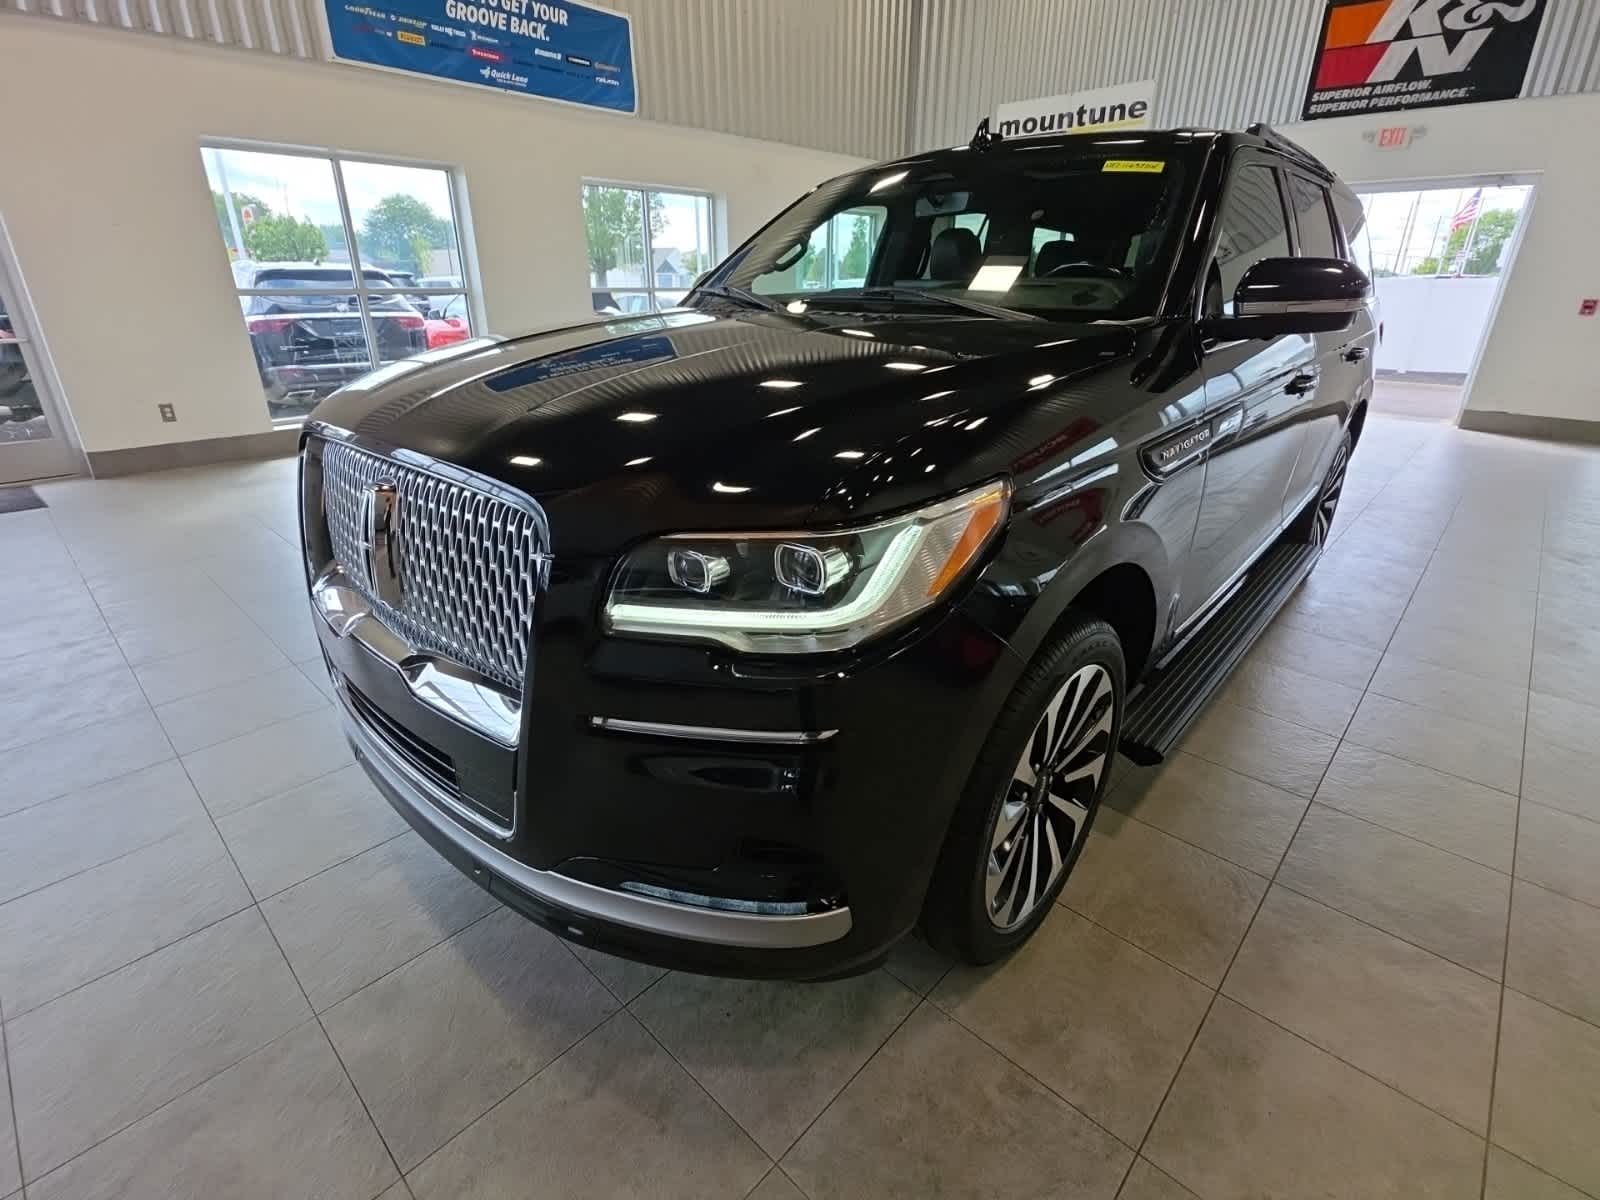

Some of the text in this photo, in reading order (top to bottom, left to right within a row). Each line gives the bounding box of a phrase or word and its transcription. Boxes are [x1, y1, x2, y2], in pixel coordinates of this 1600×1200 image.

[445, 0, 507, 31] GROOVE
[510, 16, 550, 42] BACK.
[532, 1, 568, 26] YOUR
[490, 69, 511, 80] Quick
[1311, 79, 1432, 102] SUPERIOR AIRFLOW.
[1308, 98, 1369, 114] SUPERIOR
[999, 100, 1148, 137] mountune
[1378, 127, 1408, 147] EXIT
[1160, 429, 1210, 461] NAVIGATOR
